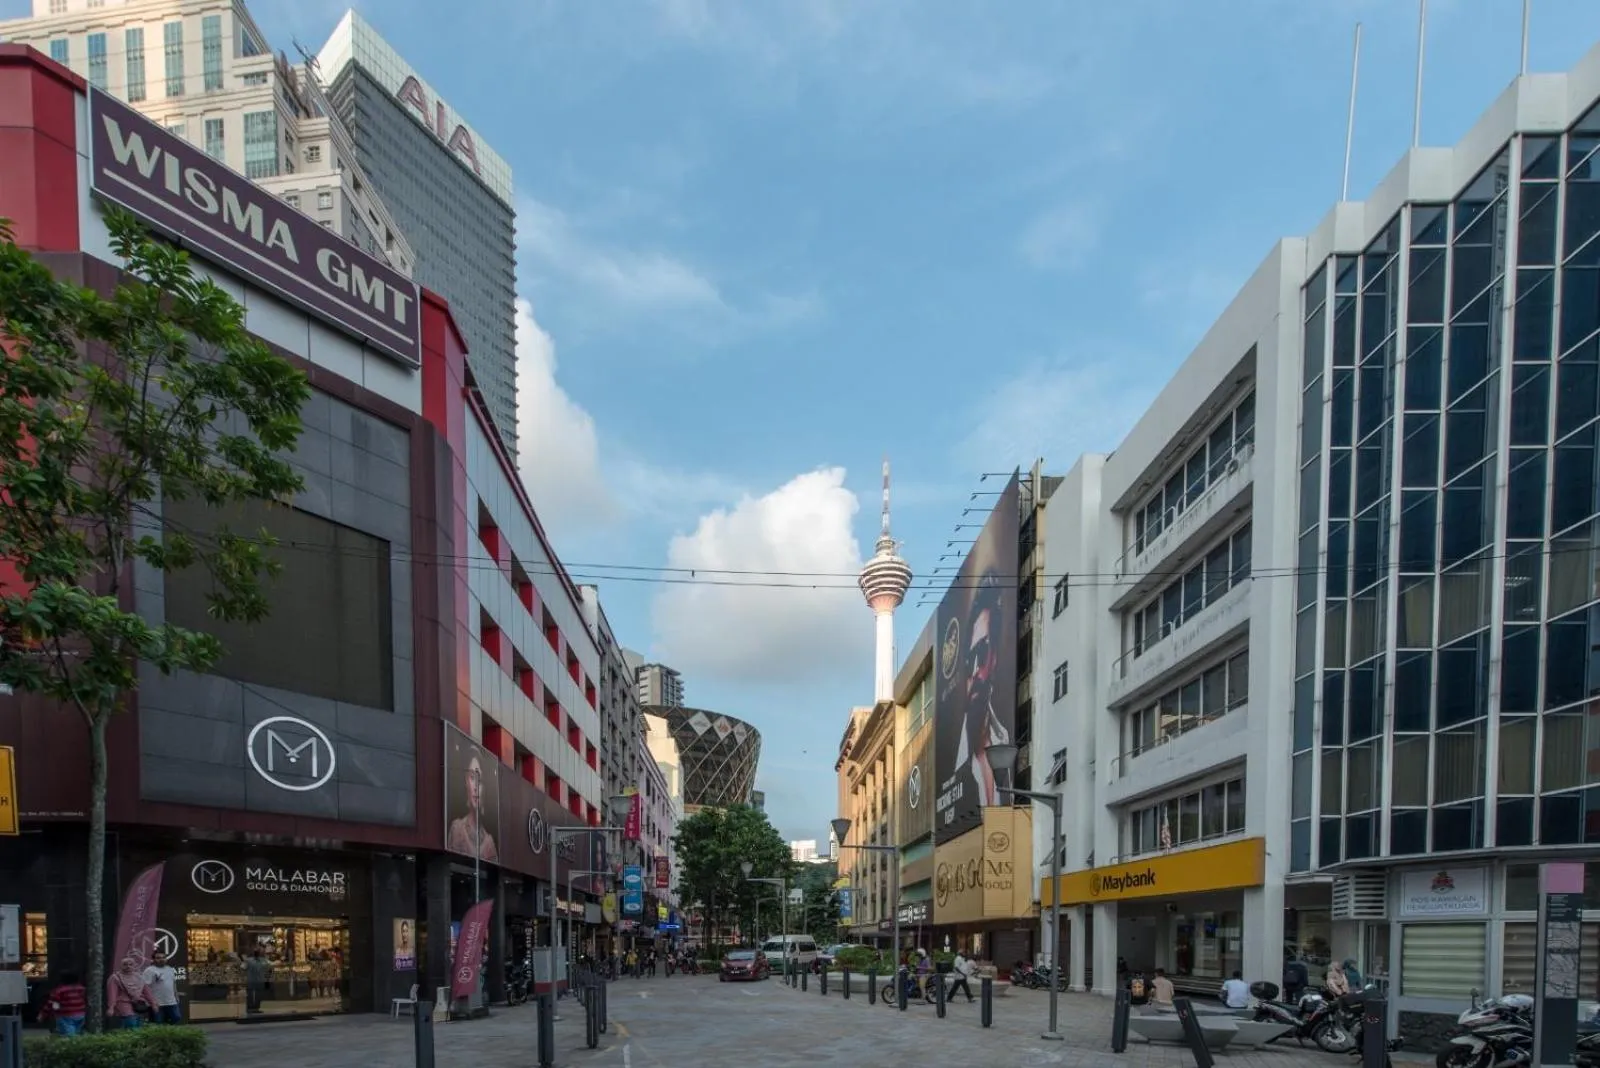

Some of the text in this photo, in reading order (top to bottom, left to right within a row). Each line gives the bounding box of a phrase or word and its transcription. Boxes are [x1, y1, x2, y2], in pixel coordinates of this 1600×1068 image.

[397, 75, 481, 176] AIA
[102, 113, 412, 324] WISMA GMT
[246, 867, 345, 885] MALABAR
[247, 882, 345, 893] GOLD & DIAMONDS
[1102, 868, 1156, 892] Maybank
